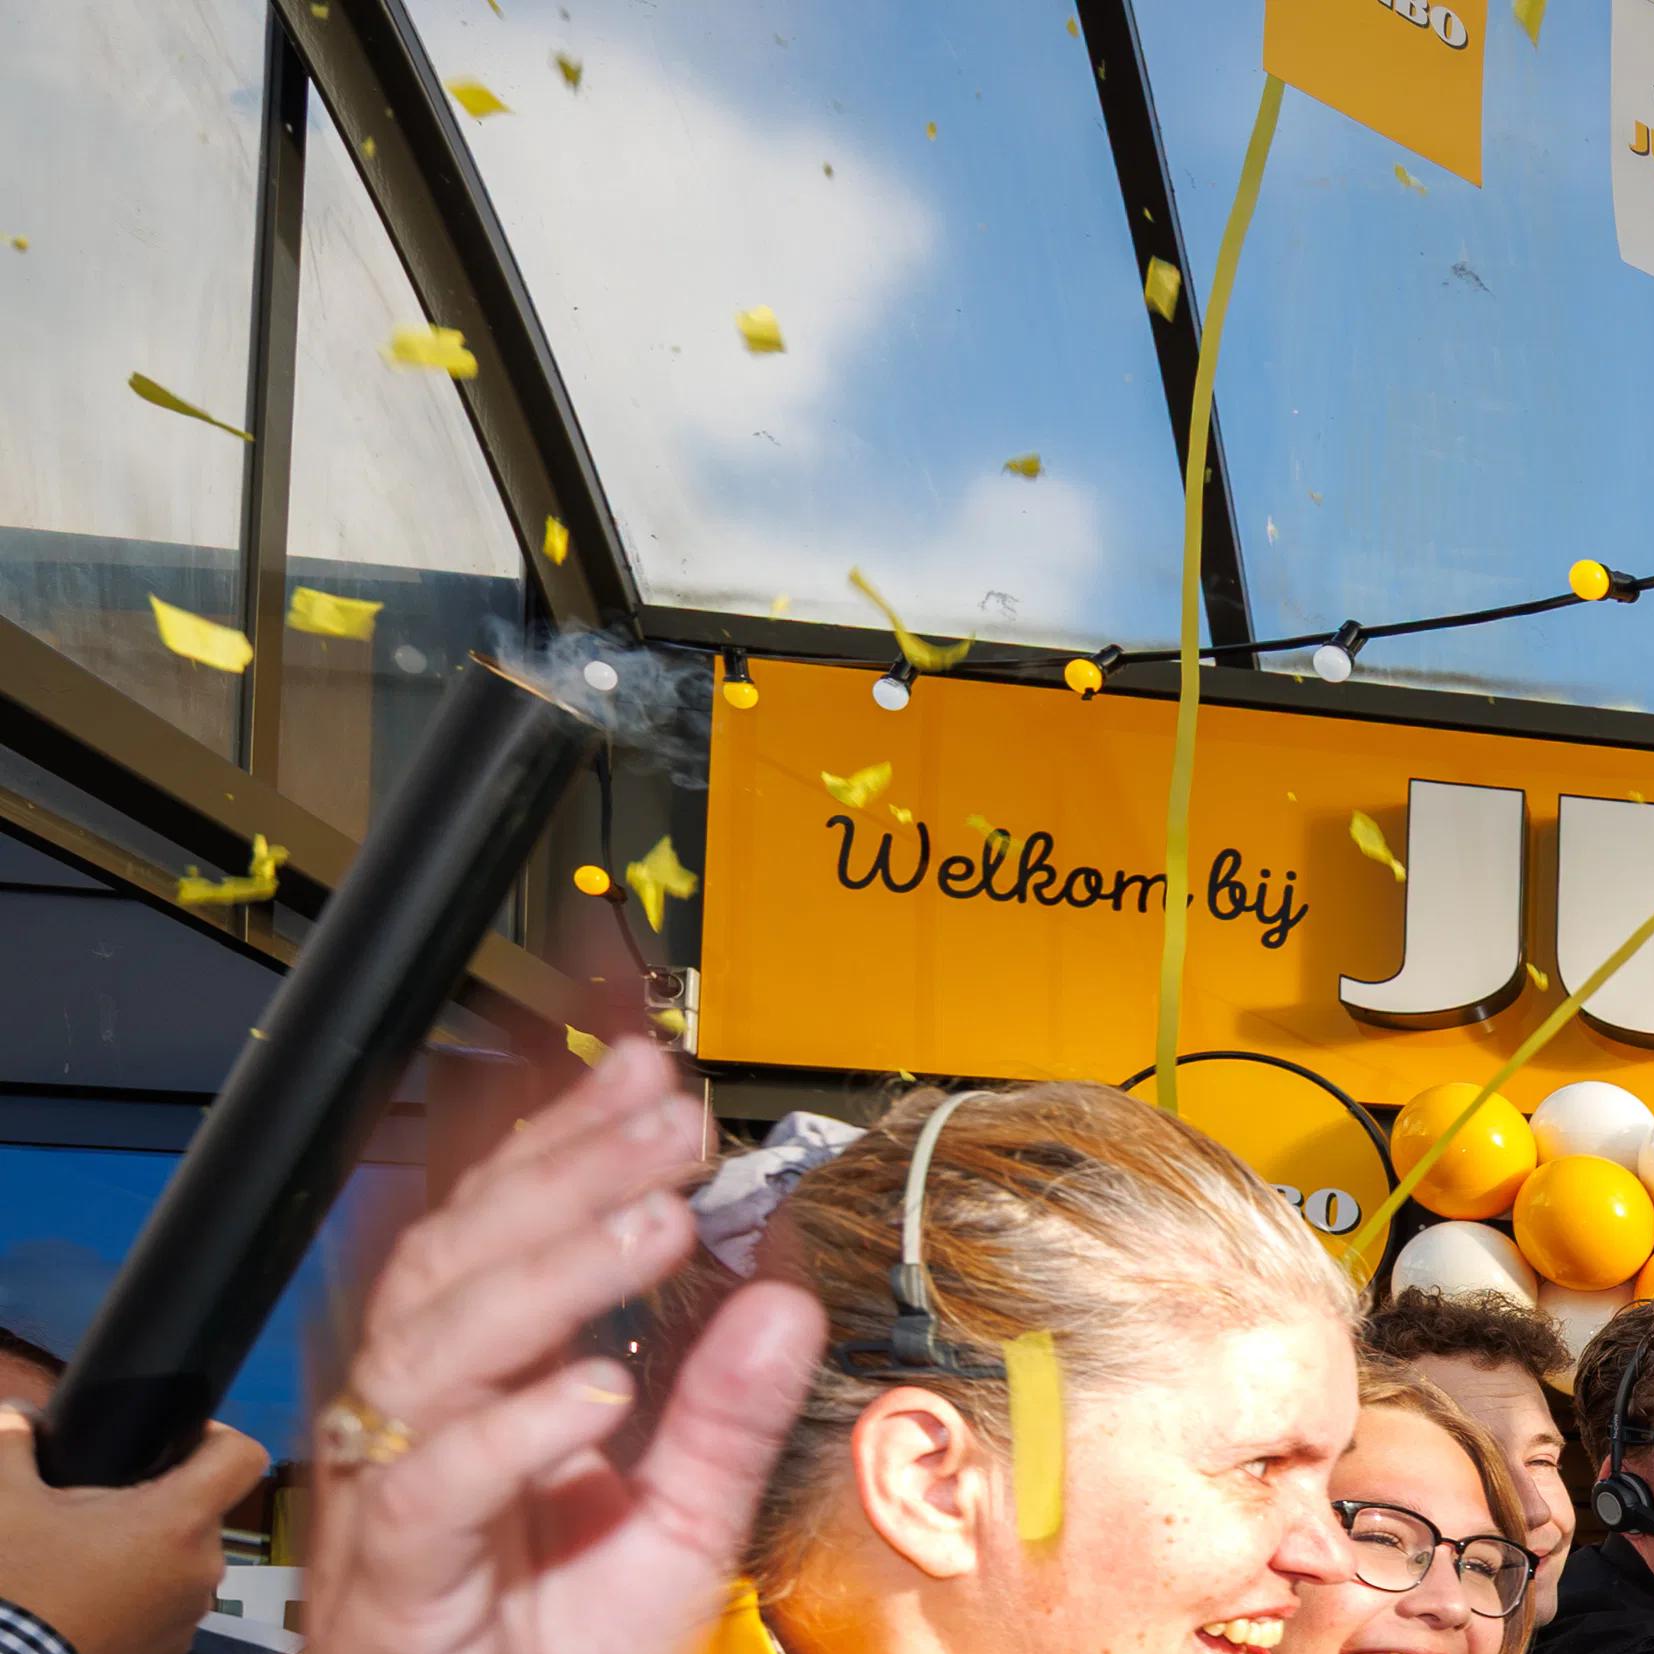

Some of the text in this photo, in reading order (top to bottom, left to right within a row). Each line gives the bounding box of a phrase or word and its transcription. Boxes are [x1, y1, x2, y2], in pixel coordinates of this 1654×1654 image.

[1376, 0, 1468, 50] BO
[825, 815, 1310, 950] Welkom bij
